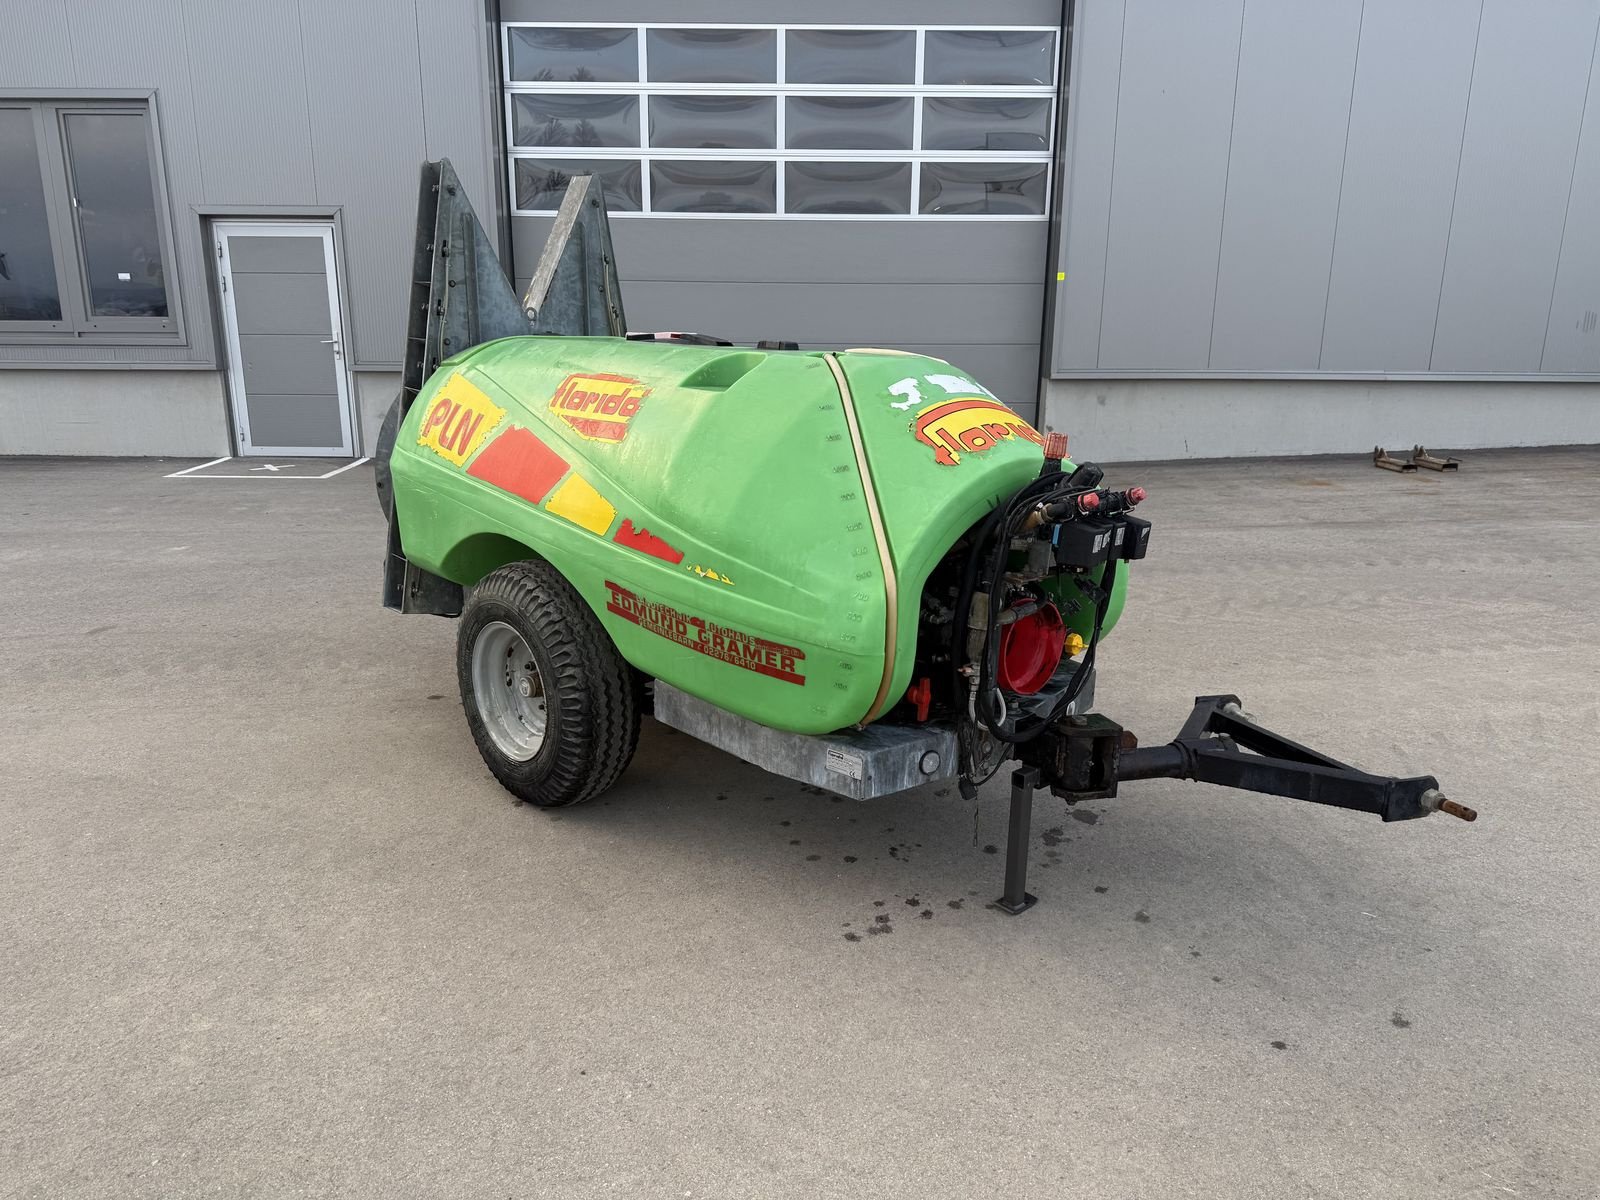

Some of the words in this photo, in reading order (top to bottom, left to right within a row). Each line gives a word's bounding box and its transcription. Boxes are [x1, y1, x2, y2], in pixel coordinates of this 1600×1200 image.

[422, 398, 484, 456] PLN
[936, 419, 1046, 466] florid
[611, 590, 687, 636] EDMUND
[639, 618, 694, 648] GEMEINLEBARN
[703, 621, 756, 647] UTOHAUS
